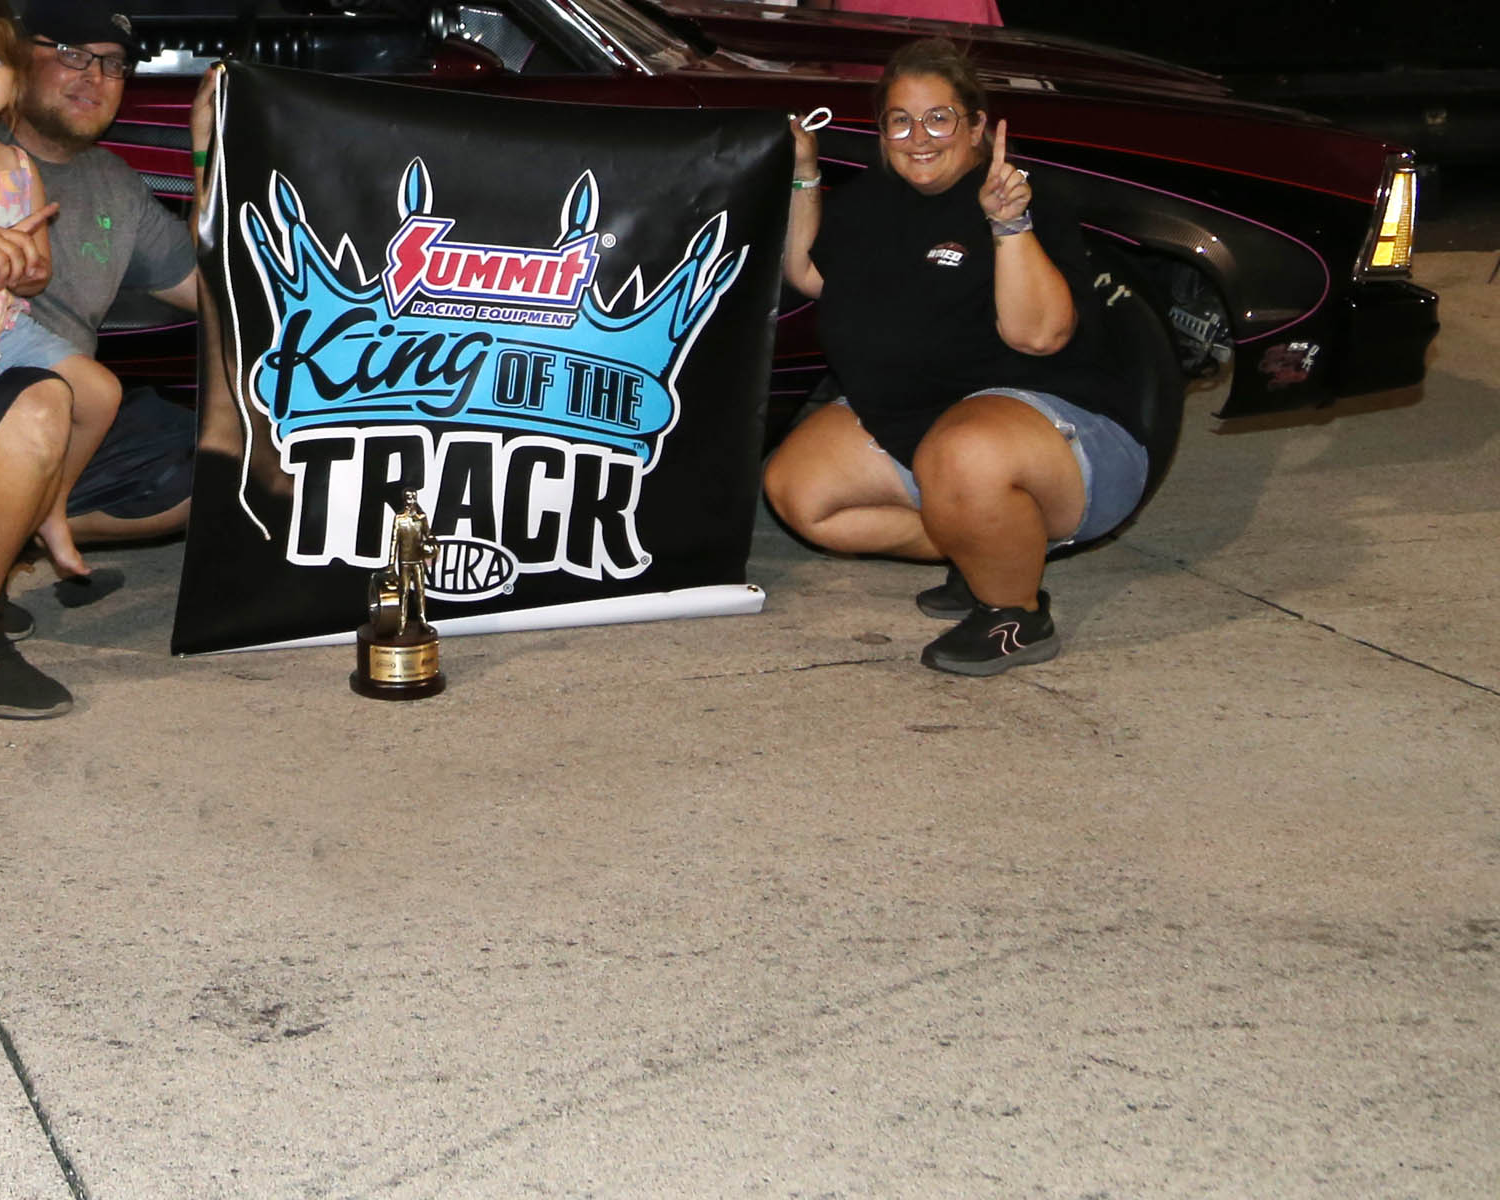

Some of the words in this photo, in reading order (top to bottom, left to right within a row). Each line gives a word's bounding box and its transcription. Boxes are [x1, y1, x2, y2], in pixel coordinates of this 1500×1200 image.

[263, 309, 493, 418] King
[493, 351, 554, 412] OF
[566, 358, 645, 430] THE
[412, 301, 475, 318] RACING
[477, 306, 575, 326] EQUIPMENT
[287, 433, 643, 572] TRACK
